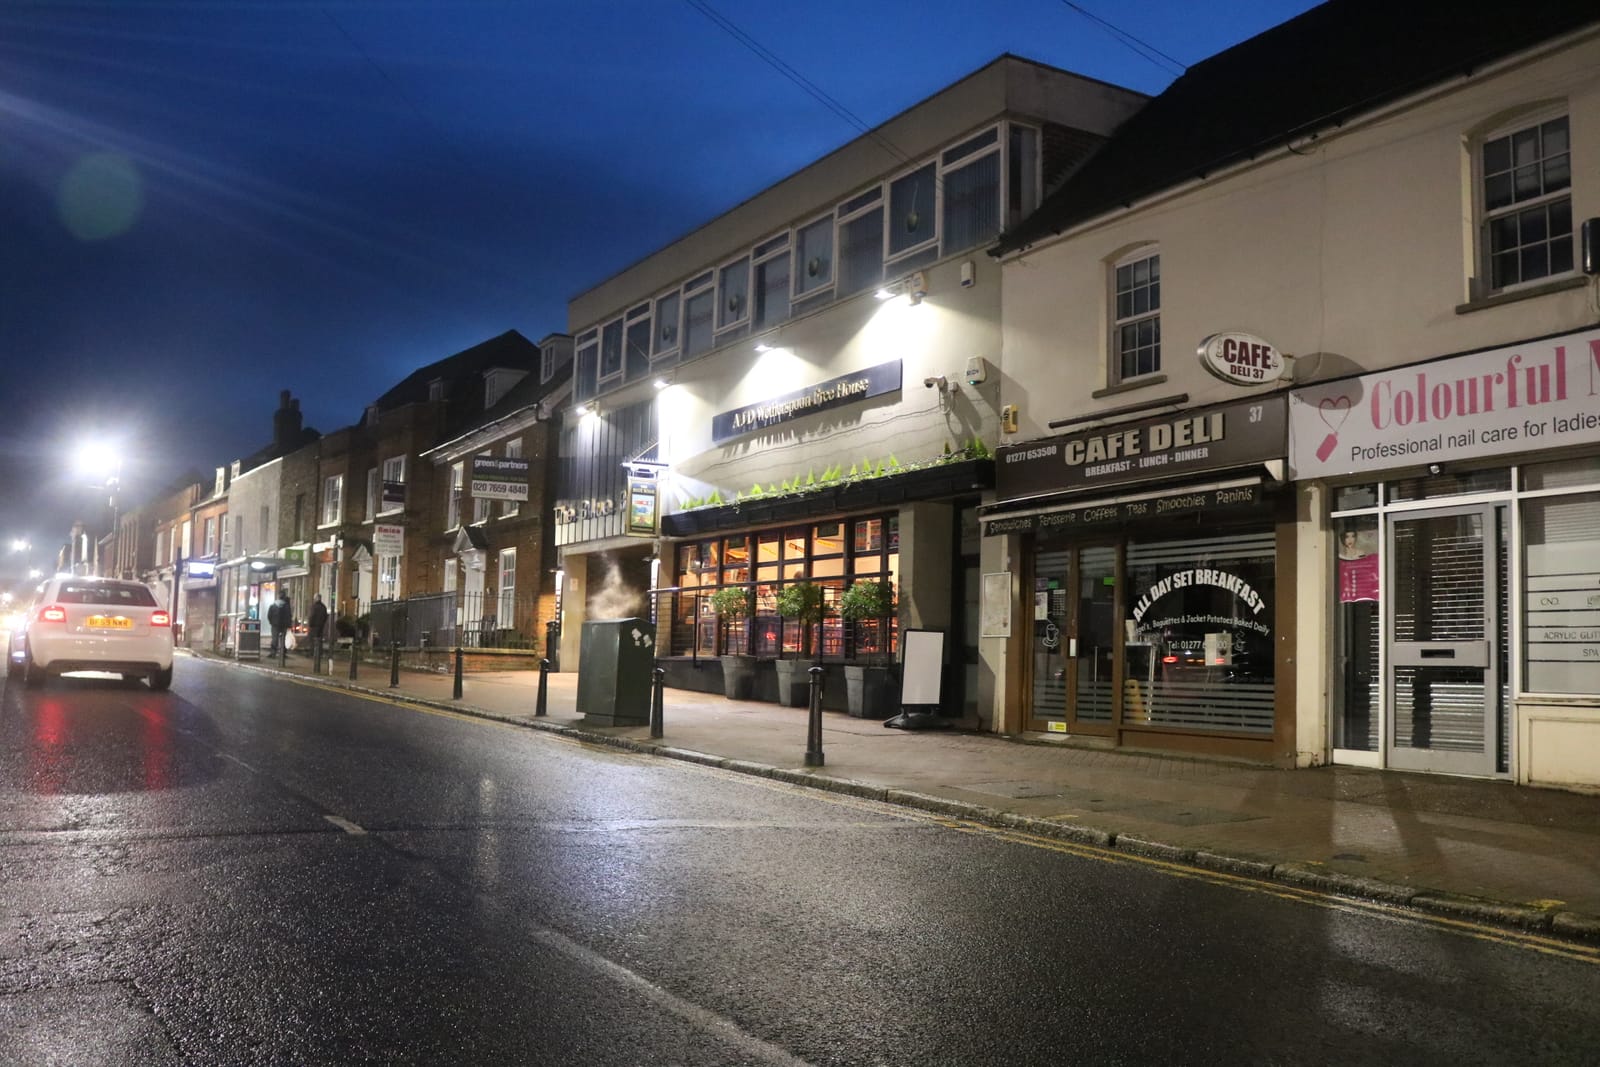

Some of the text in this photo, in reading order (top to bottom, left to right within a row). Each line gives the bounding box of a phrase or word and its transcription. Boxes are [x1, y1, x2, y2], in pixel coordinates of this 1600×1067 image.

[1223, 338, 1273, 370] CAFE
[1229, 366, 1265, 380] DELI 37
[837, 378, 869, 398] House
[1369, 344, 1570, 431] Colourful
[1248, 405, 1263, 424] 37
[1063, 412, 1227, 466] CAFE DELI
[1350, 433, 1443, 462] Professional
[1447, 430, 1476, 449] nail
[1480, 425, 1518, 444] care
[1523, 419, 1549, 438] for
[1005, 451, 1026, 465] 01277
[1084, 460, 1131, 478] BREAKFAST
[1138, 454, 1169, 469] LUNCH
[1174, 447, 1209, 463] DINNER
[472, 482, 488, 492] 020
[553, 504, 577, 525] The
[580, 497, 614, 520] Blue
[989, 518, 1033, 535] Sandwiches
[1083, 507, 1118, 523] Coffees
[1126, 502, 1148, 516] Teas
[1156, 492, 1206, 514] Smoothies
[1216, 487, 1253, 505] Paninis
[1132, 568, 1266, 623] ALL DAY SET BREAKFAST
[1186, 614, 1207, 624] Jacket
[1207, 614, 1234, 625] Potatoes
[1234, 617, 1253, 629] Baked
[1253, 621, 1271, 636] Daily
[1544, 631, 1577, 640] ACRYLIC
[1167, 640, 1180, 650] Tel:
[1180, 640, 1202, 650] 01277
[1582, 648, 1599, 657] SPA
